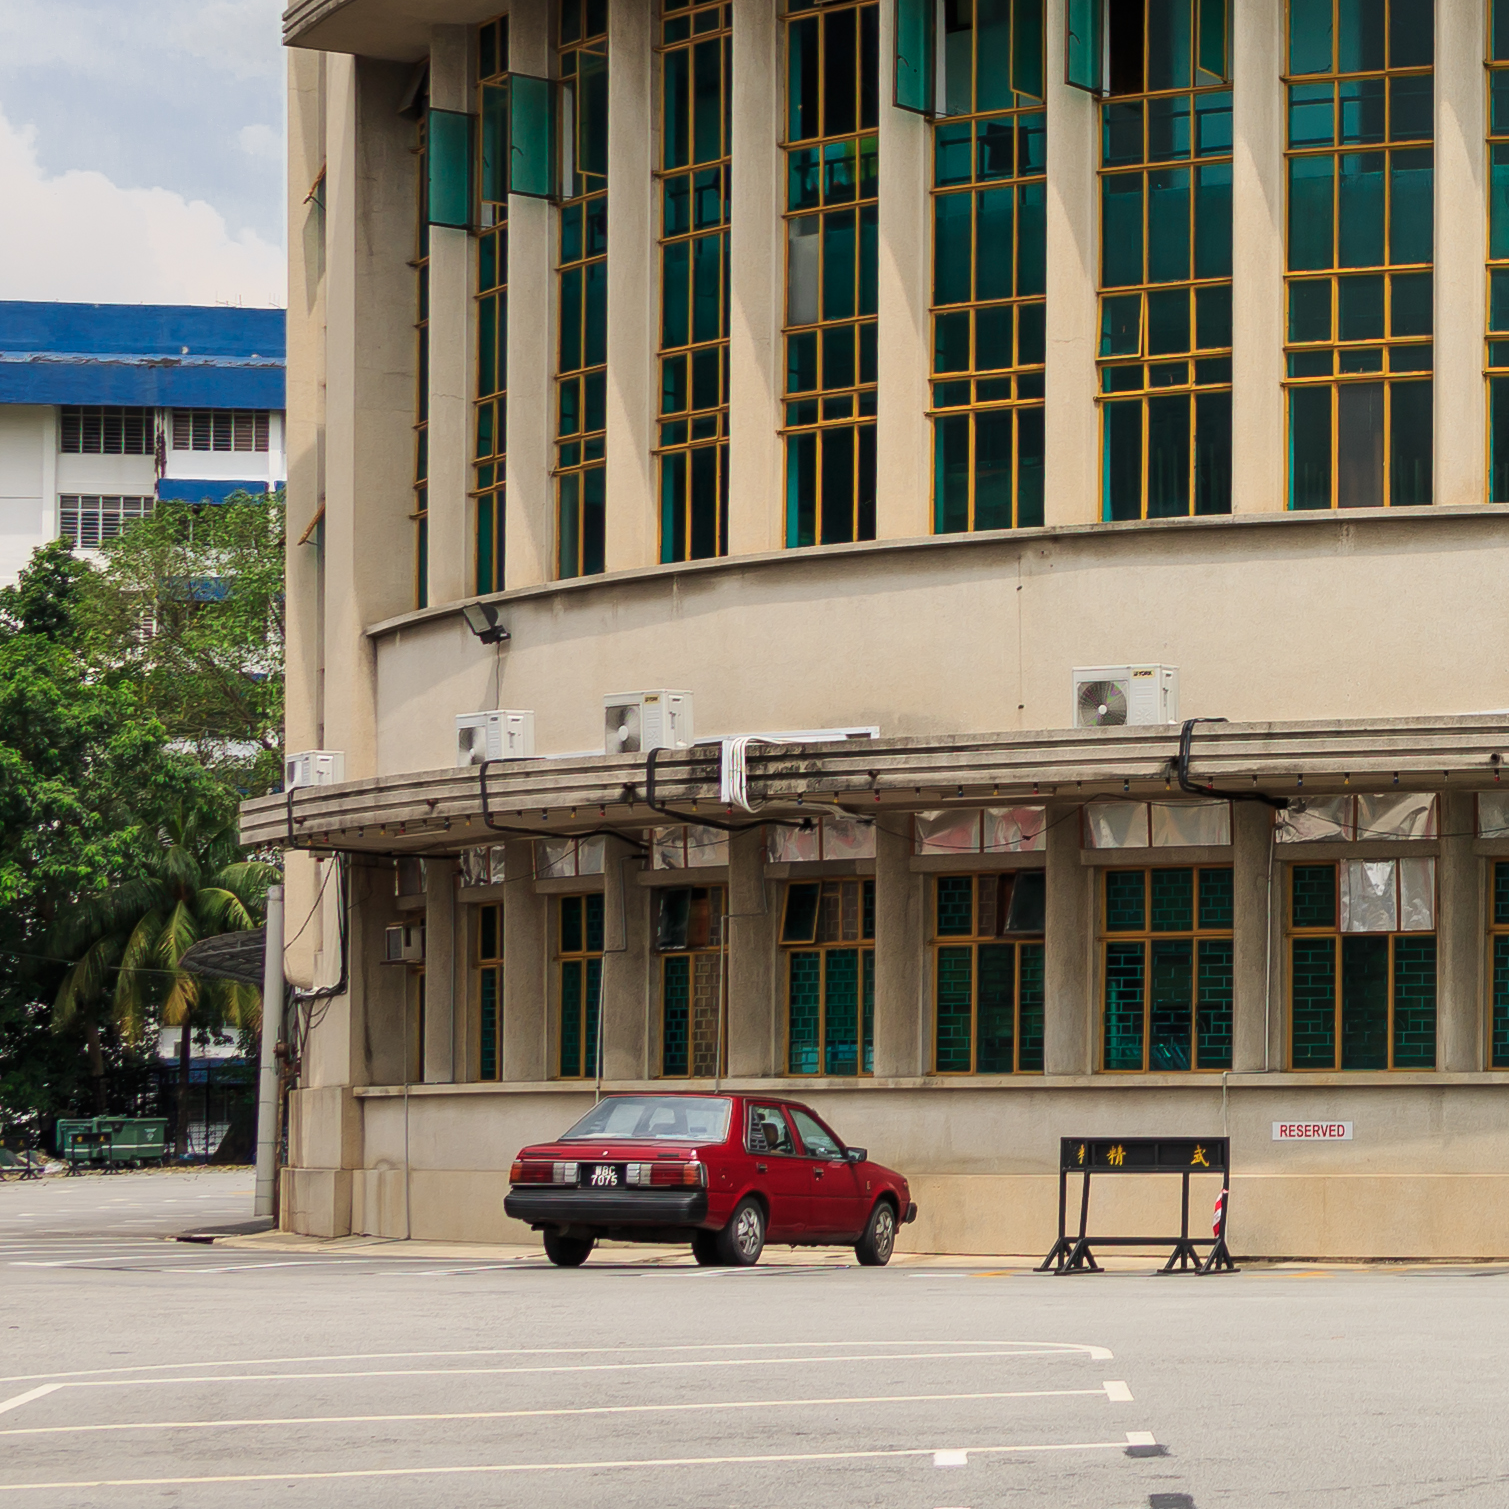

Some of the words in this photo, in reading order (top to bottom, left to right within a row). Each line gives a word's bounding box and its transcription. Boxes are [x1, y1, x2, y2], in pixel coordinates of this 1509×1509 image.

[1279, 1124, 1346, 1139] RESERVED
[1106, 1144, 1210, 1167] 精武
[594, 1165, 616, 1176] WBC
[590, 1175, 618, 1186] 7075
